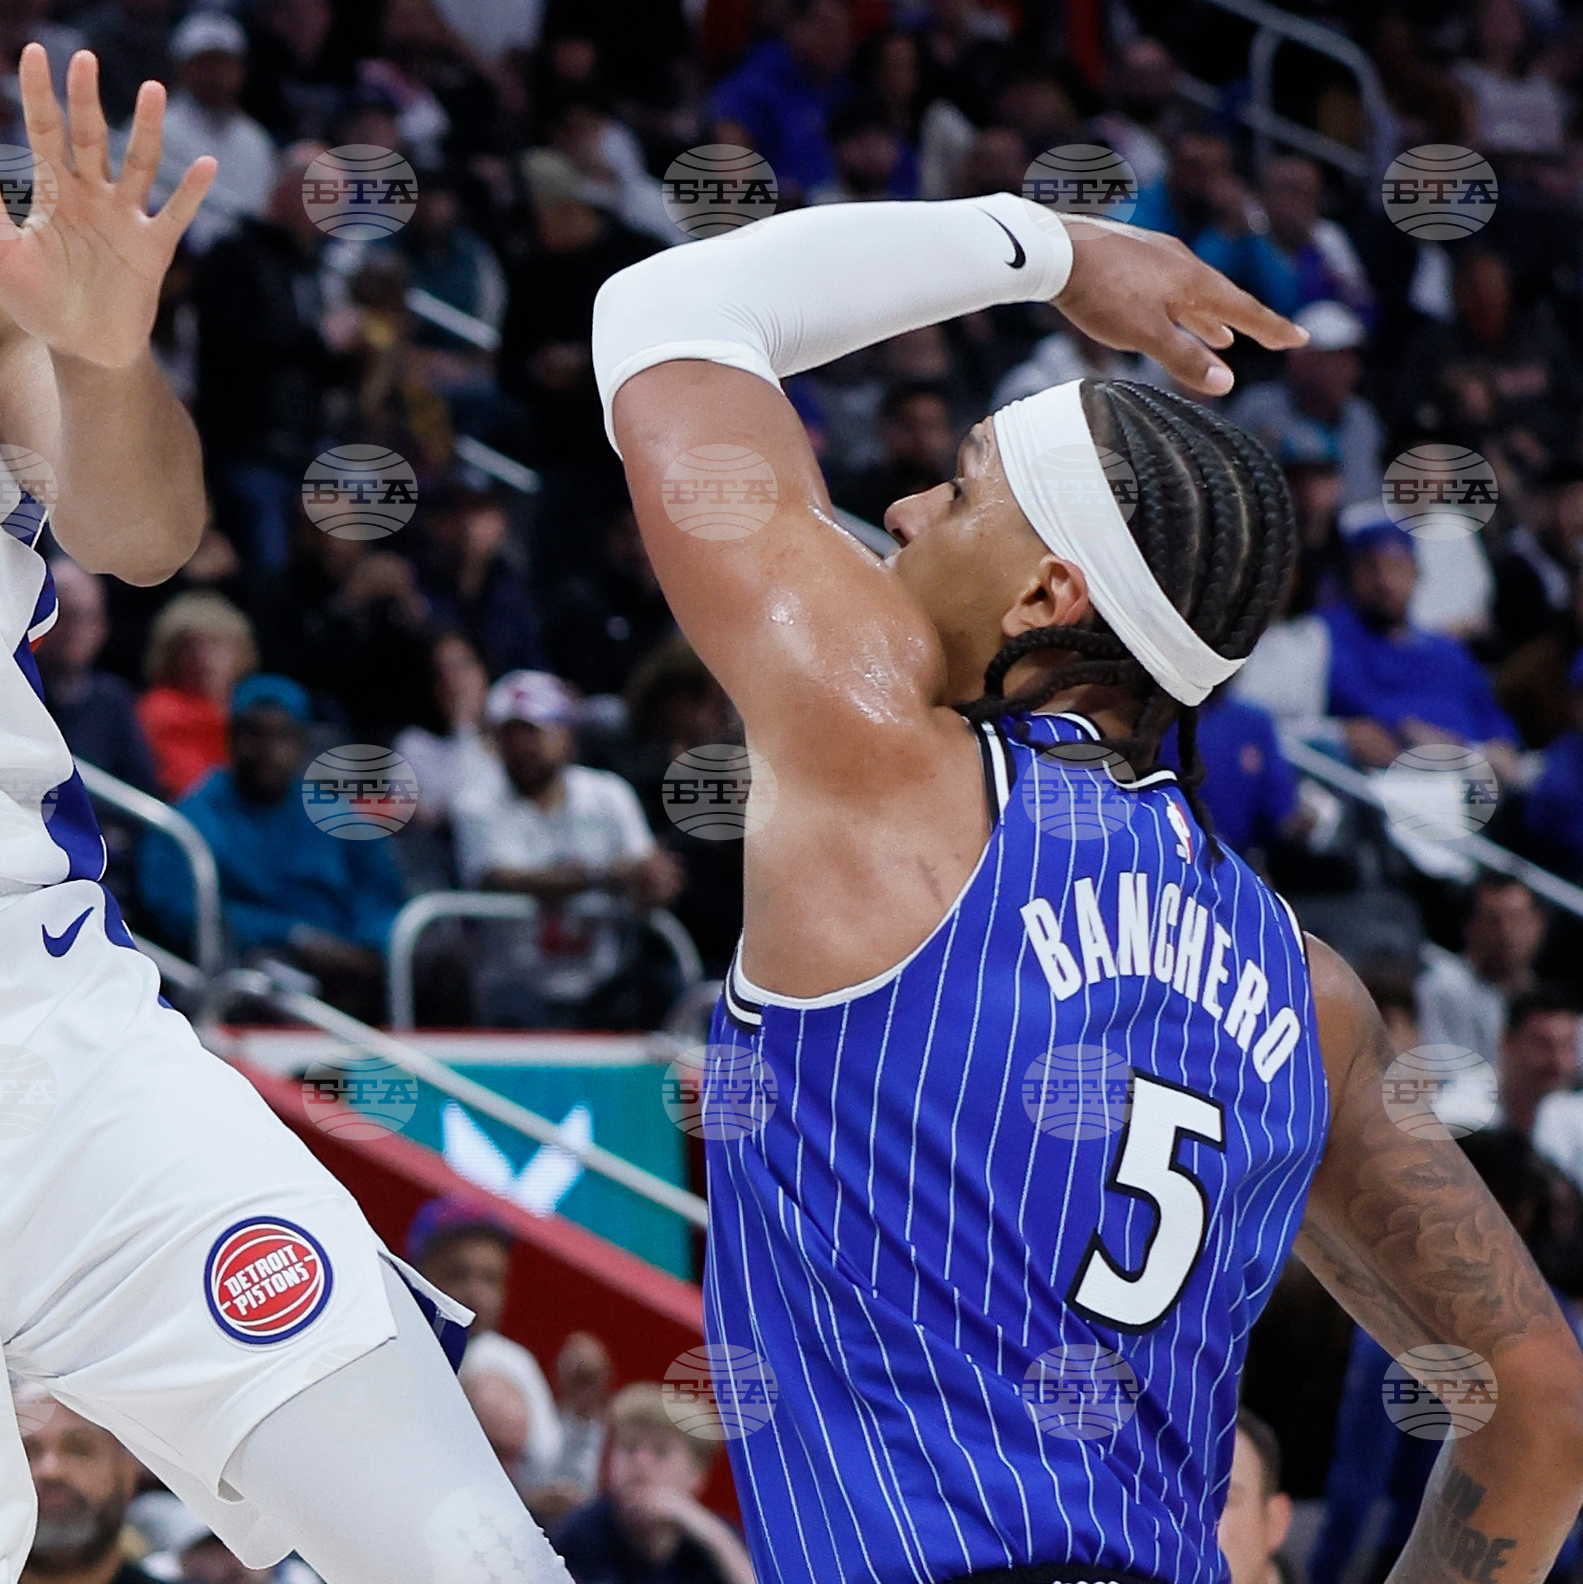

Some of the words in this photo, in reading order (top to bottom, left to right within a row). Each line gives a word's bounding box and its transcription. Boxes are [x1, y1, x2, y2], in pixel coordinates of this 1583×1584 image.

[1020, 872, 1301, 1084] BANCHERO
[223, 1244, 299, 1297] DETROIT
[1067, 1073, 1226, 1335] 5
[232, 1261, 311, 1316] PISTONS
